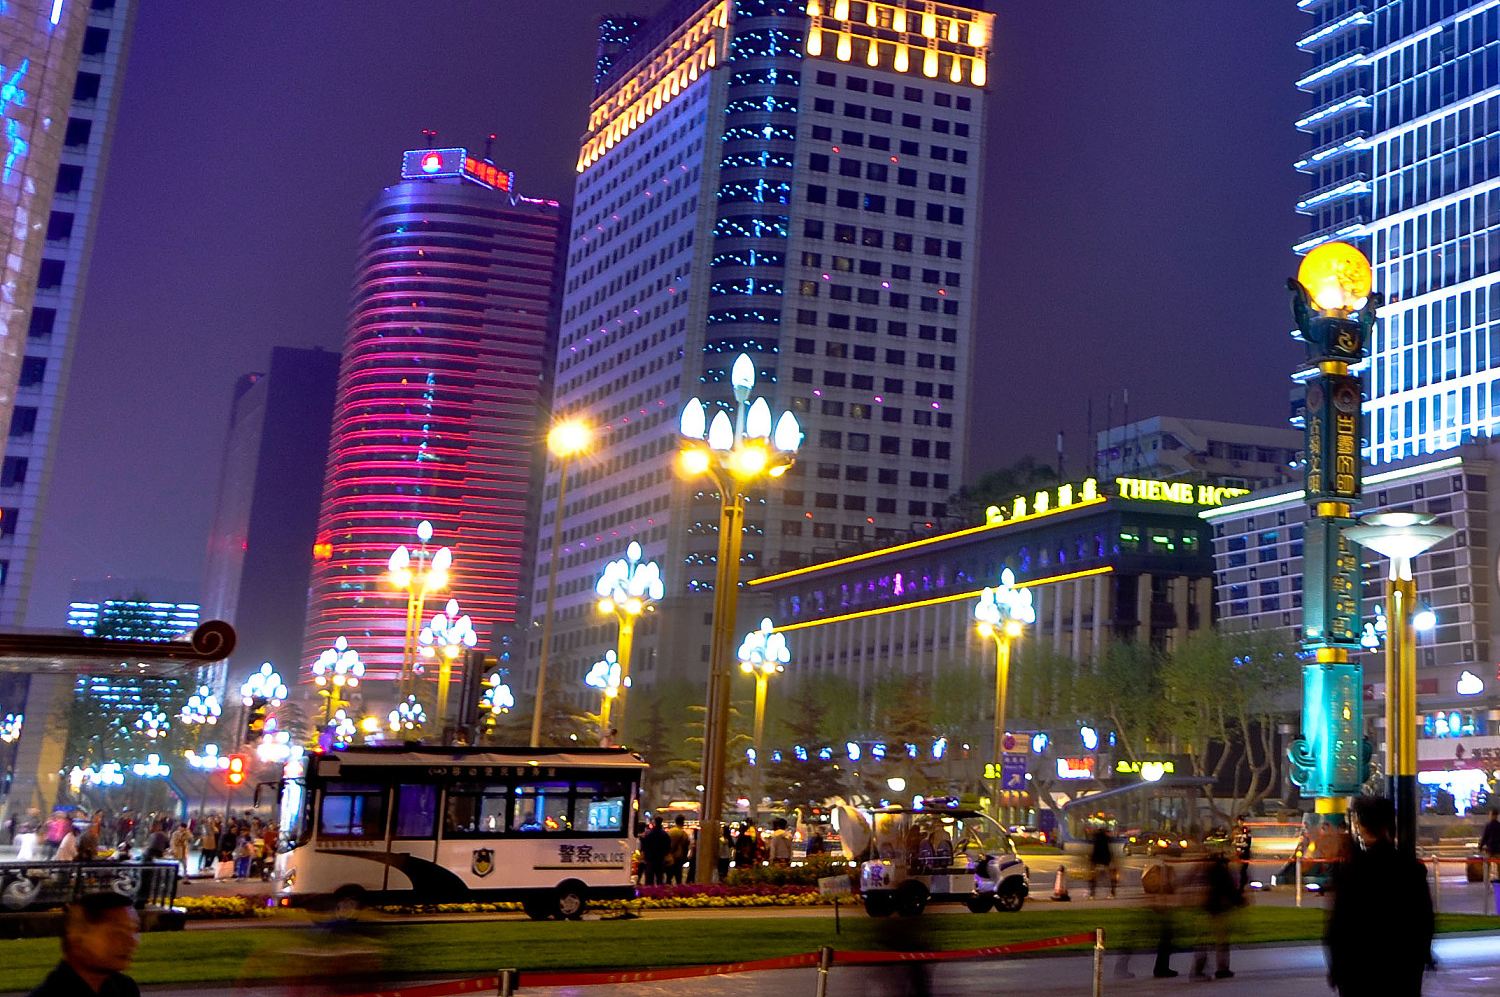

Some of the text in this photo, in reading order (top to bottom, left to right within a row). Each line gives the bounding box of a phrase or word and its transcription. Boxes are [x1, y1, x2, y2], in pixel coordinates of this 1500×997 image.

[1116, 478, 1193, 504] THEME
[558, 844, 593, 863] 警察
[593, 852, 625, 863] POLICE
